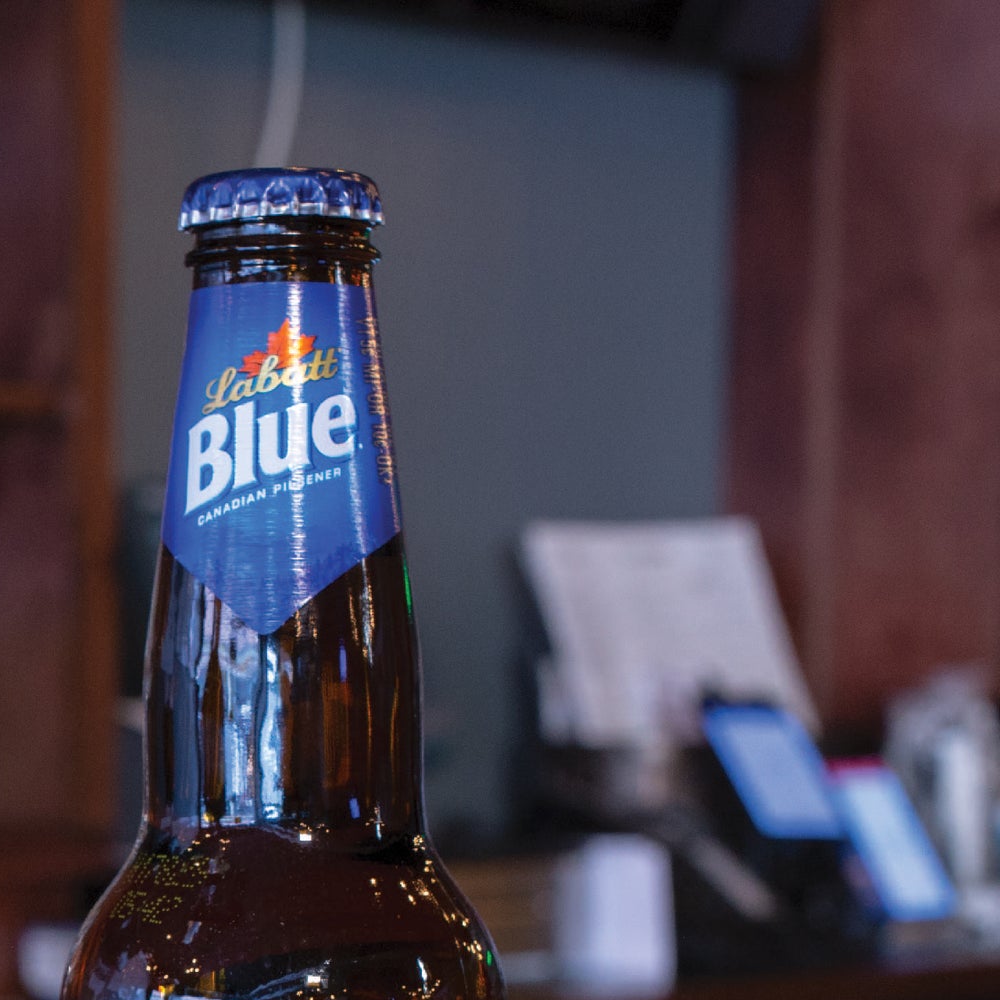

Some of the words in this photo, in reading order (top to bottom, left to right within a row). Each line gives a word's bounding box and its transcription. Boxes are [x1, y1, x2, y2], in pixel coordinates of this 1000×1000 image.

[202, 347, 339, 415] Labatt
[184, 394, 357, 517] Blue
[197, 489, 267, 526] CANADIAN
[273, 467, 342, 496] PILSENER
